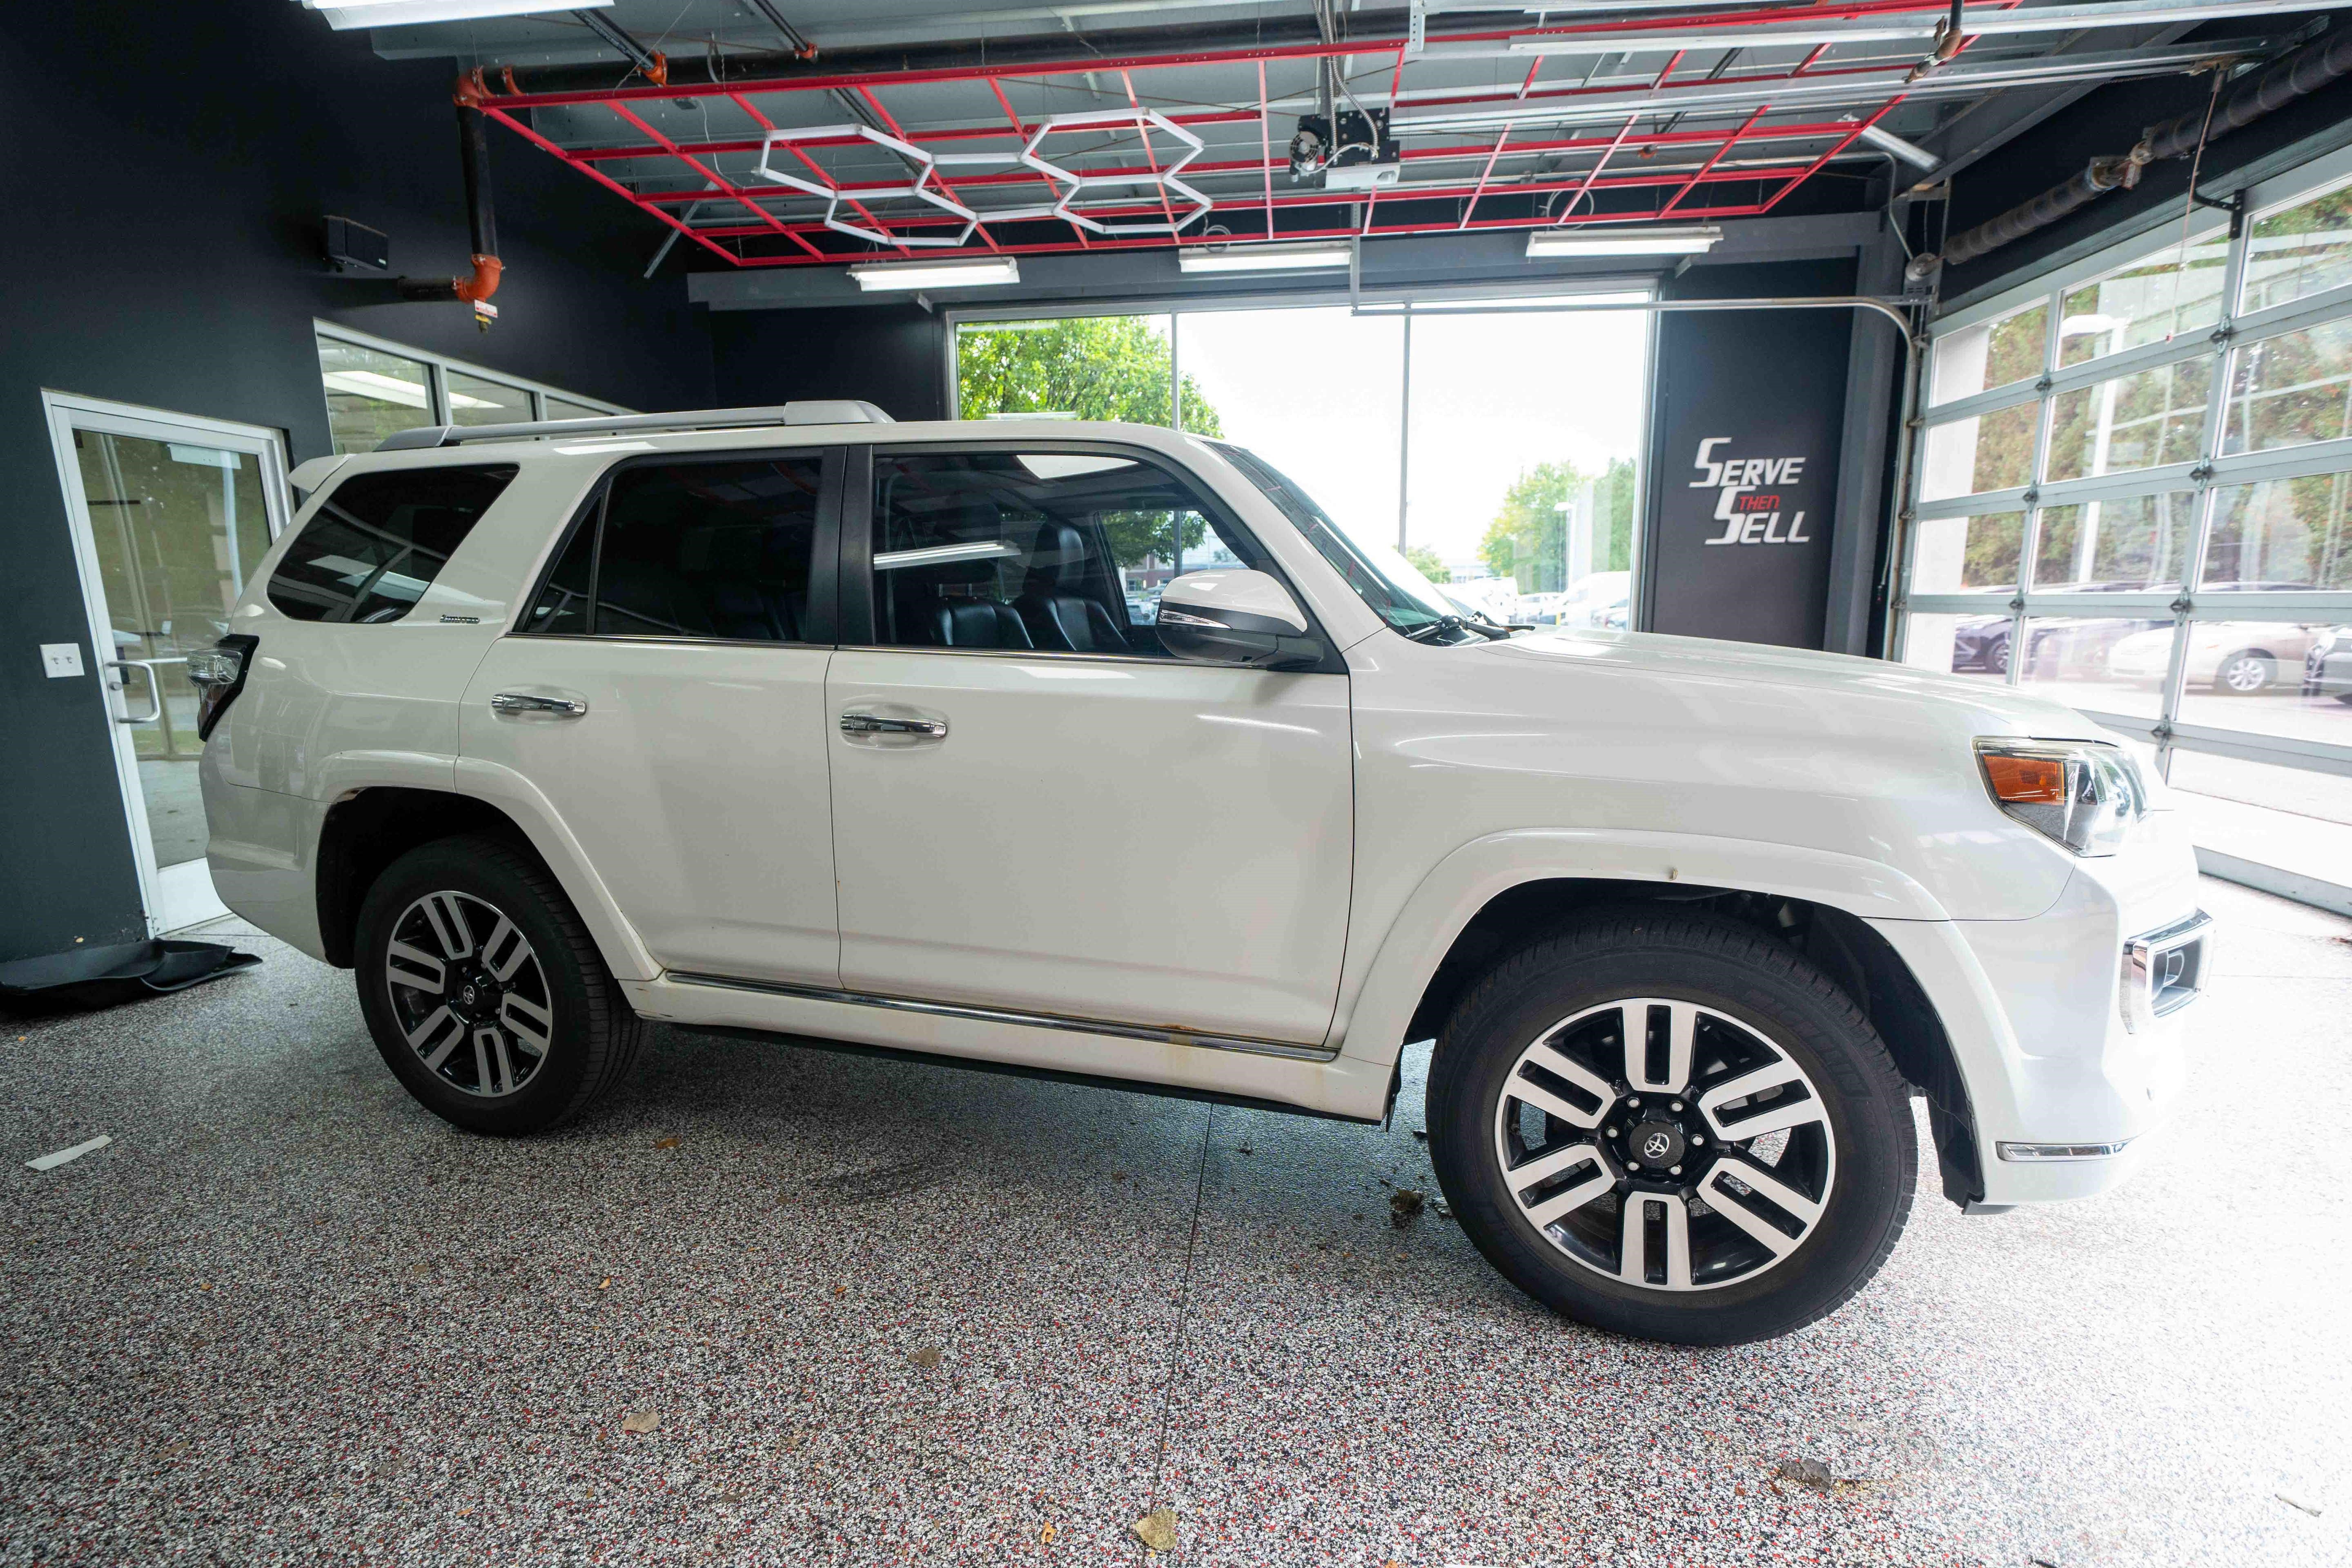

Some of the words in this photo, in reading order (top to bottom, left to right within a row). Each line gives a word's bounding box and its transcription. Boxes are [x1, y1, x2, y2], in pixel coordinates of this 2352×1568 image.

[1689, 437, 1806, 488] SERVE
[1705, 485, 1810, 545] SELL
[1739, 494, 1780, 510] THEN
